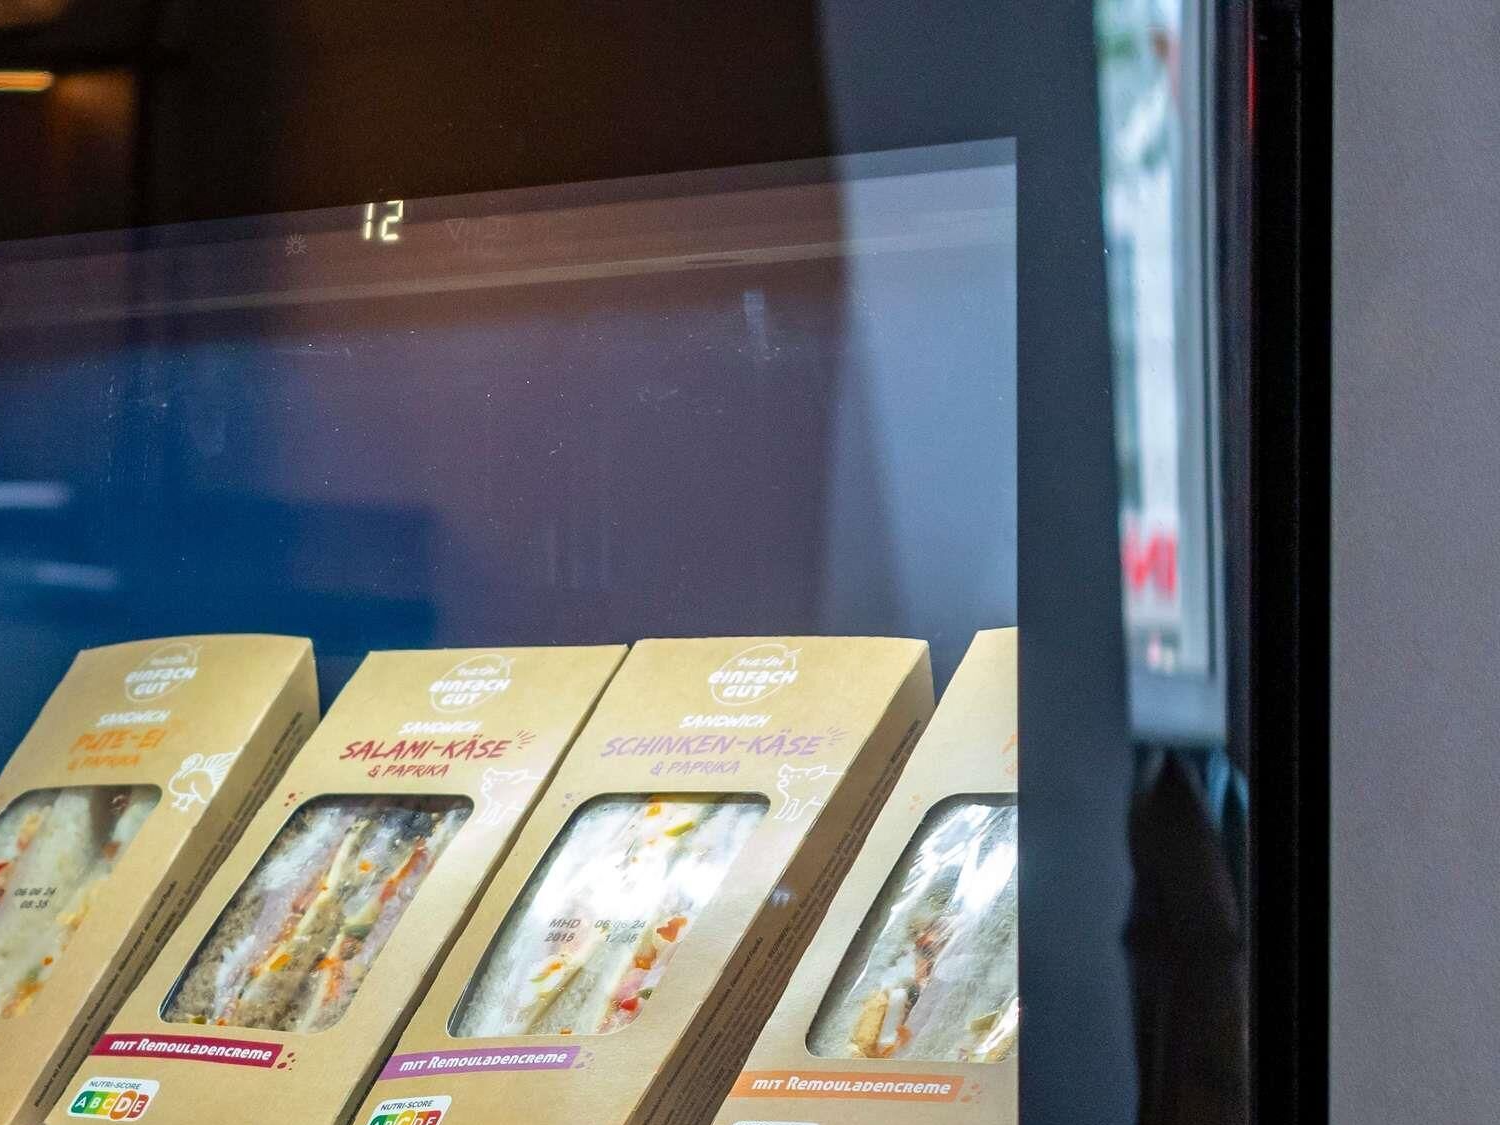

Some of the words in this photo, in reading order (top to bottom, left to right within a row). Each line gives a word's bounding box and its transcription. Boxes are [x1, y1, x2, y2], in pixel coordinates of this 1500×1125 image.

[363, 200, 403, 240] 12
[722, 684, 767, 698] GUT
[398, 720, 484, 735] SANDWICH
[679, 713, 772, 729] SANDWICH
[339, 734, 513, 760] SALAMI-KÄSE
[601, 729, 827, 758] SCHINKEN-KÄSE
[382, 763, 451, 778] PAPRIKA
[666, 760, 741, 777] PAPRIKA
[88, 1080, 143, 1091] NUTRI-SCORE
[380, 1100, 434, 1112] NUTRI-SCORE
